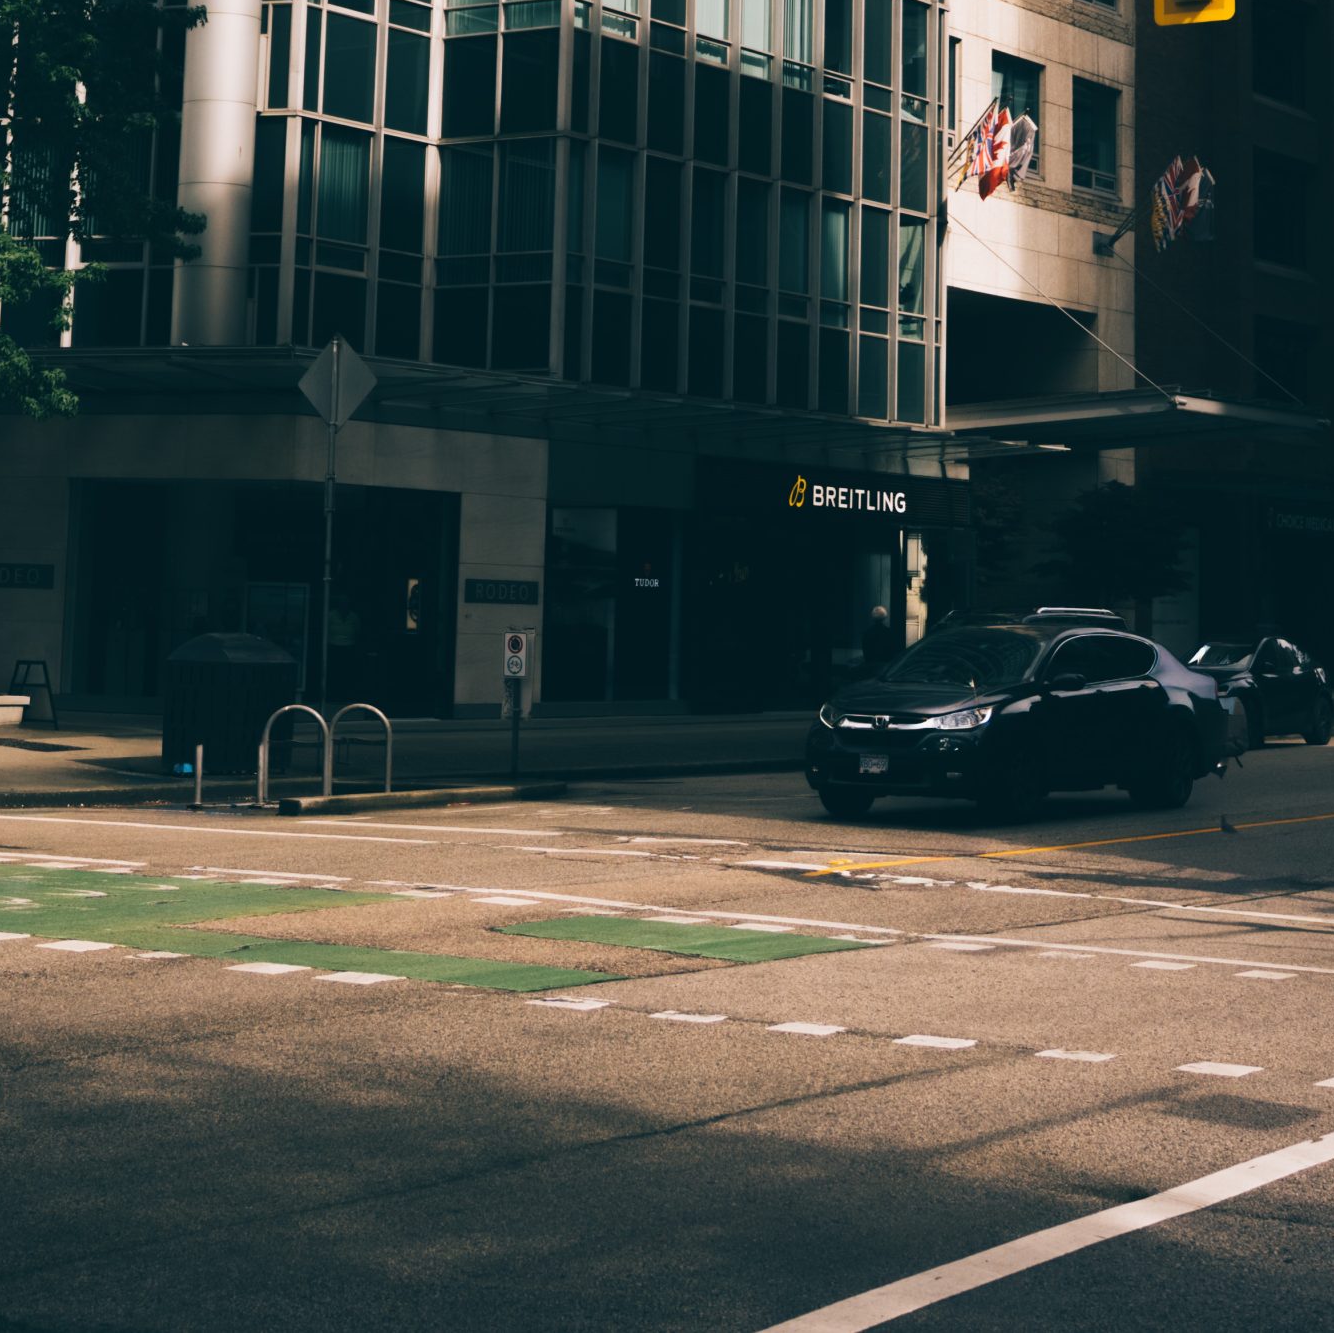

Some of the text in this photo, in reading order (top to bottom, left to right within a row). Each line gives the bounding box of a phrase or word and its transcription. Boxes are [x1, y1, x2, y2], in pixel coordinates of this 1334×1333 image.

[812, 484, 907, 514] BREITLING
[634, 577, 660, 588] TUDOR
[475, 583, 529, 601] RODEO
